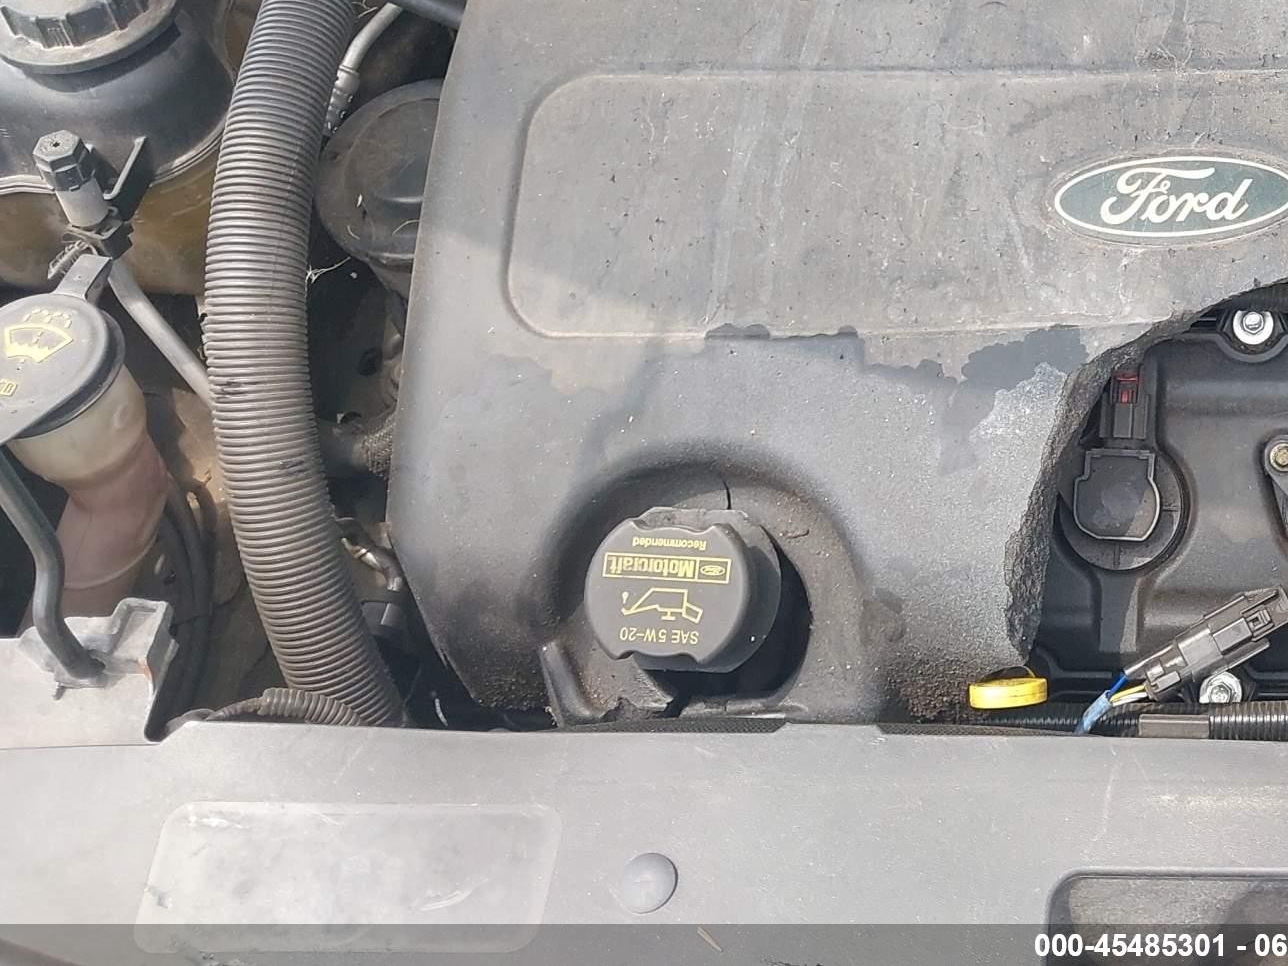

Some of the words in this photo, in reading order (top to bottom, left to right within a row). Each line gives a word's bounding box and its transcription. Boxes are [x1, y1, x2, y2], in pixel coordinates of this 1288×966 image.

[1100, 167, 1254, 225] Ford
[632, 536, 707, 551] Recommended
[609, 556, 695, 579] Motorcraft
[620, 626, 667, 644] 5W-20
[672, 629, 699, 645] SAE
